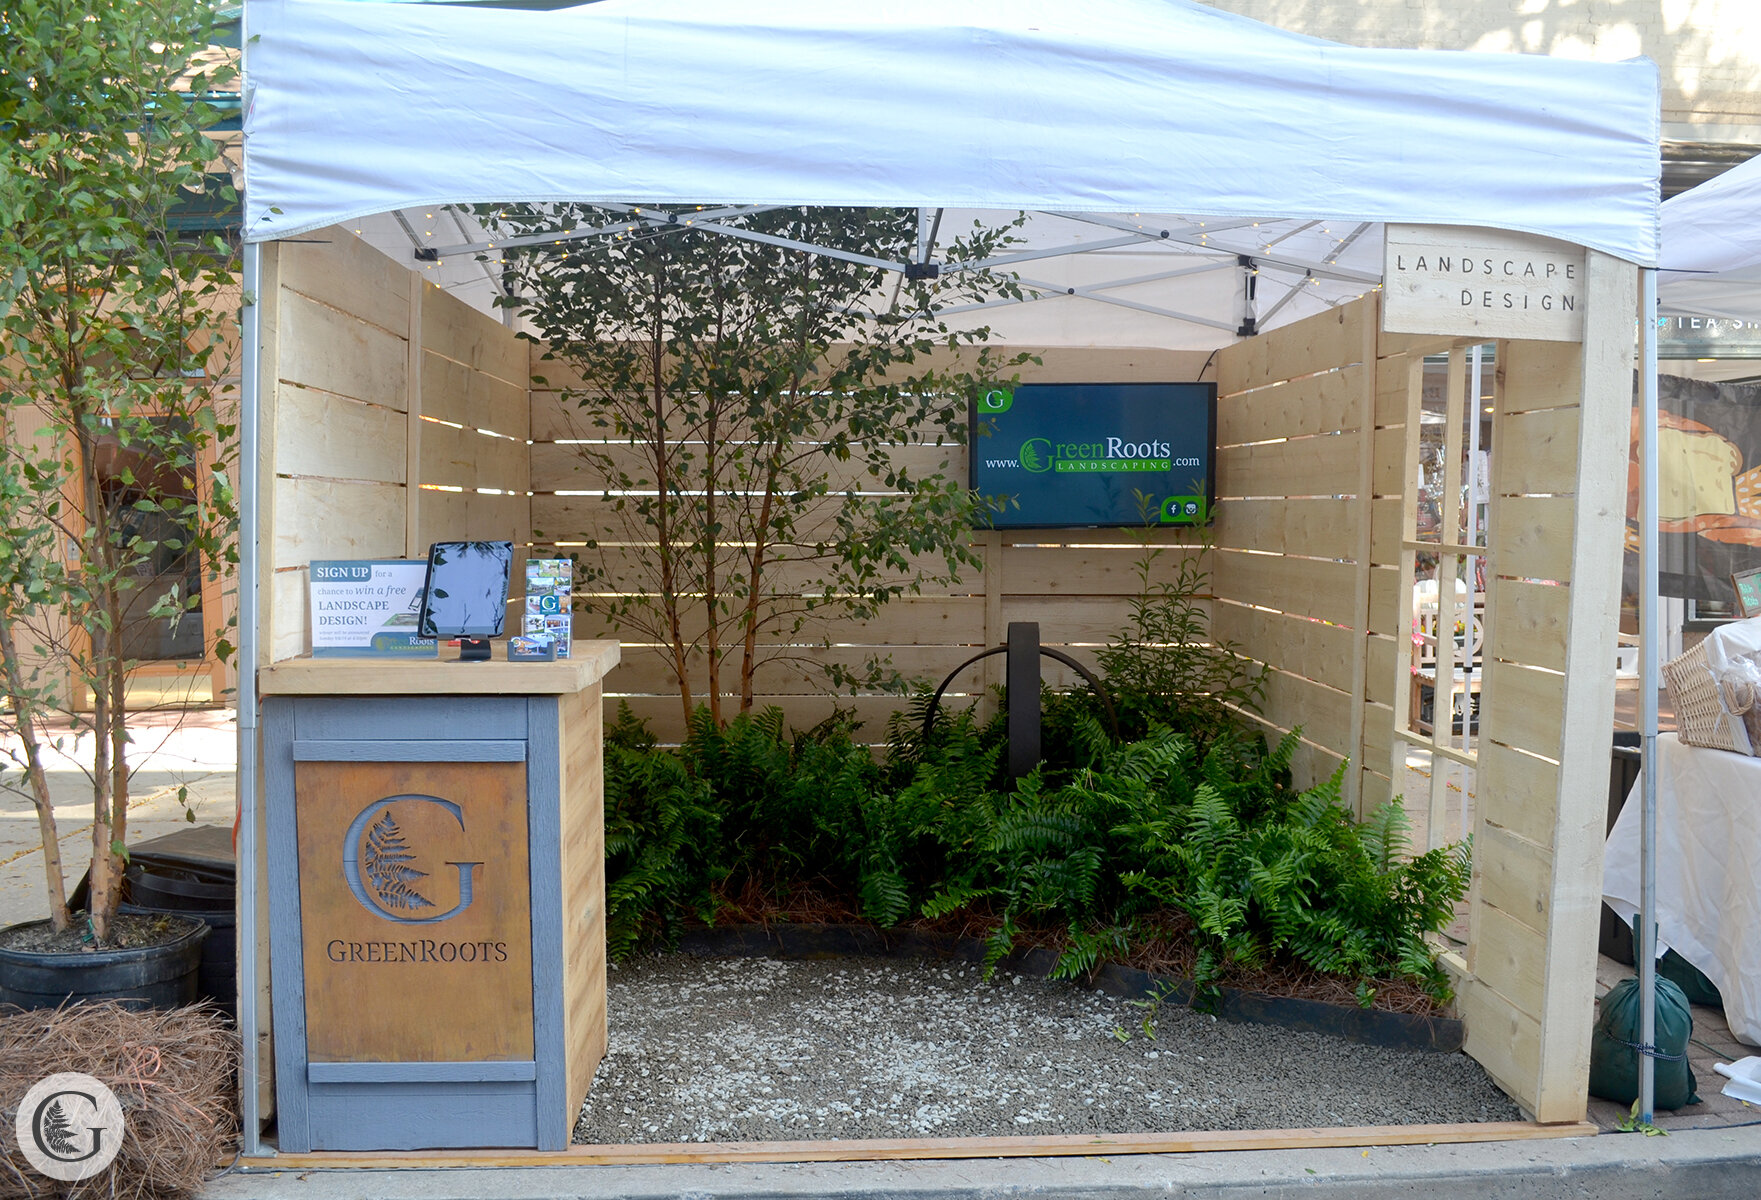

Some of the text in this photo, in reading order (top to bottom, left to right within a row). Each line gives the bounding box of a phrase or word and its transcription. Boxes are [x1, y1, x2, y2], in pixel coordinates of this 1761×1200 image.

[1397, 254, 1575, 279] LANDSCAPE
[1461, 290, 1575, 311] DESIGN
[986, 390, 1004, 408] G
[1058, 460, 1169, 470] LANDSCAPING
[317, 567, 348, 578] SIGN
[352, 567, 369, 578] UP
[317, 587, 344, 595] chance
[355, 585, 374, 595] win
[386, 585, 407, 597] free
[319, 601, 389, 610] LANDSCAPE
[319, 616, 367, 625] DESIGN!
[343, 794, 484, 925] G
[327, 939, 508, 962] GREENROOTS
